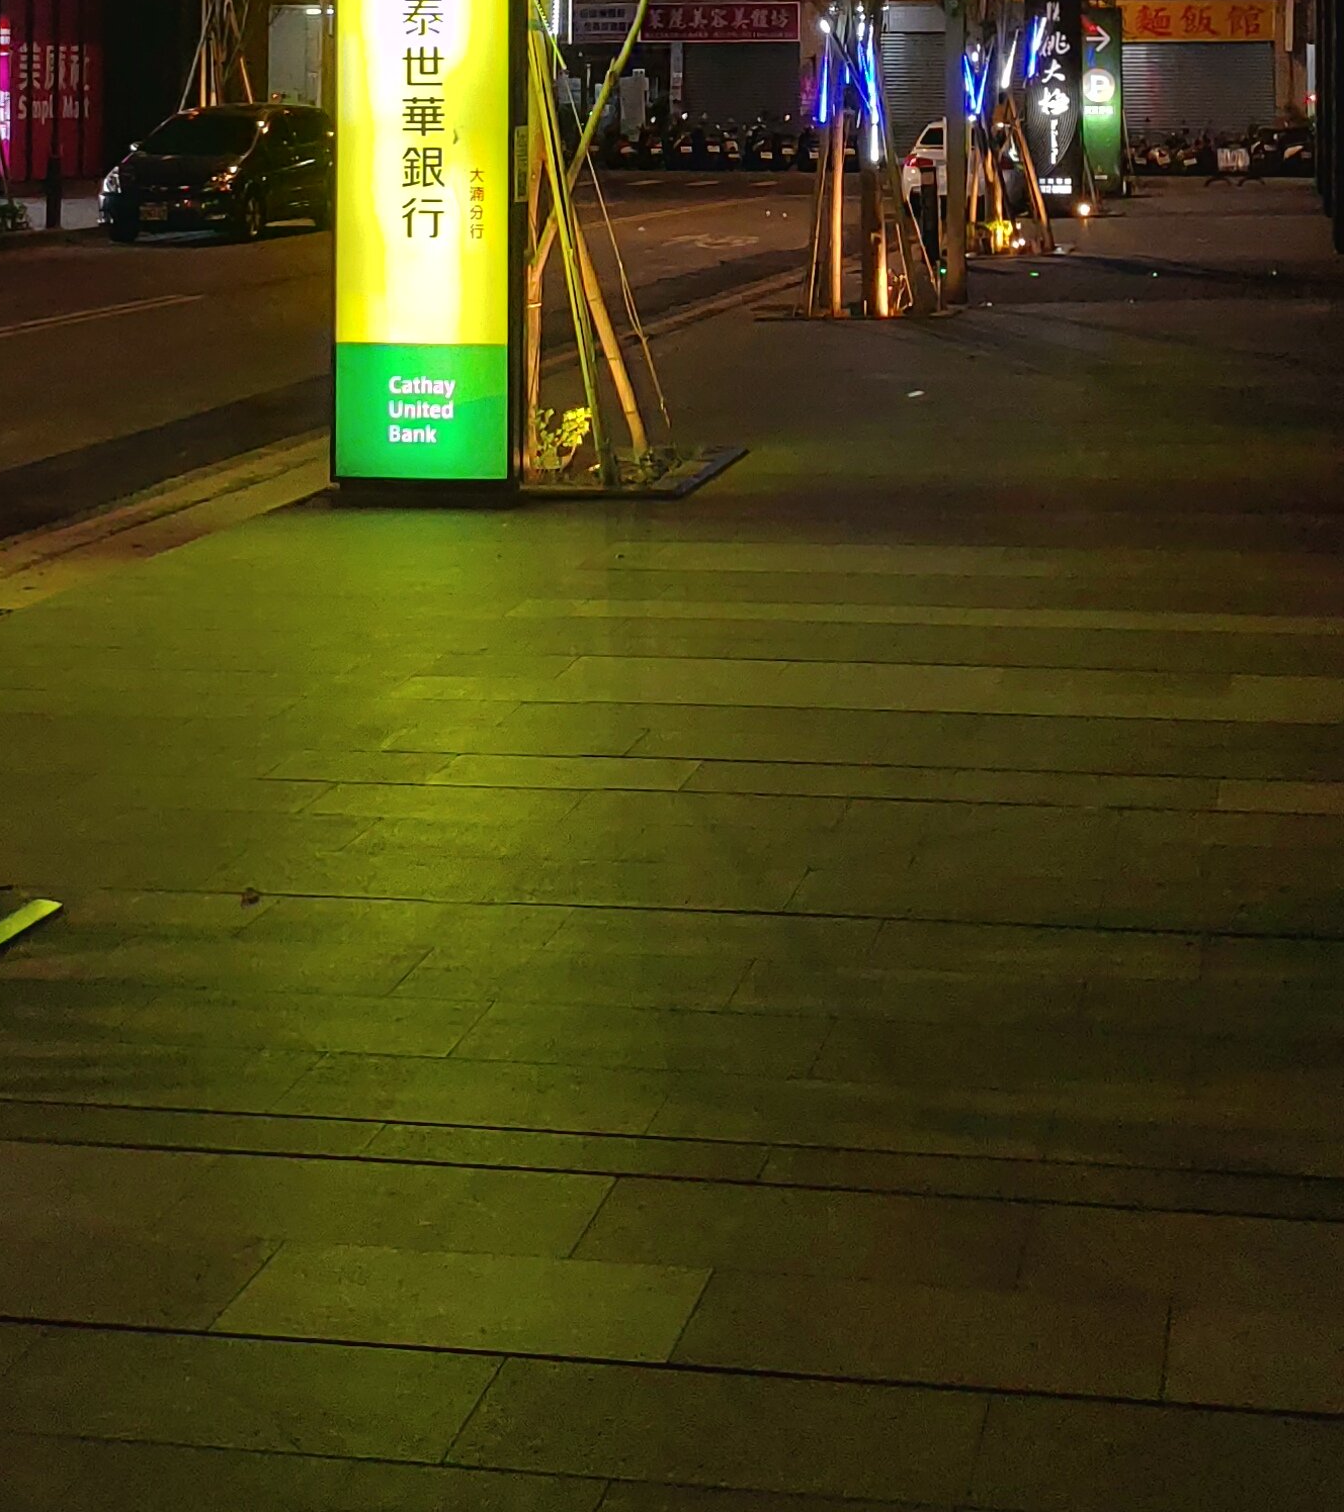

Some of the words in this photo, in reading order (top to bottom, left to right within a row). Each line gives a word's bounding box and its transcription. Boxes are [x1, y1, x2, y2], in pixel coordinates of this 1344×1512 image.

[1123, 3, 1266, 38] 麵飯館
[469, 167, 485, 240] 大湳分行
[388, 375, 456, 399] Cathay
[388, 399, 454, 420] United
[388, 424, 437, 443] Bank
